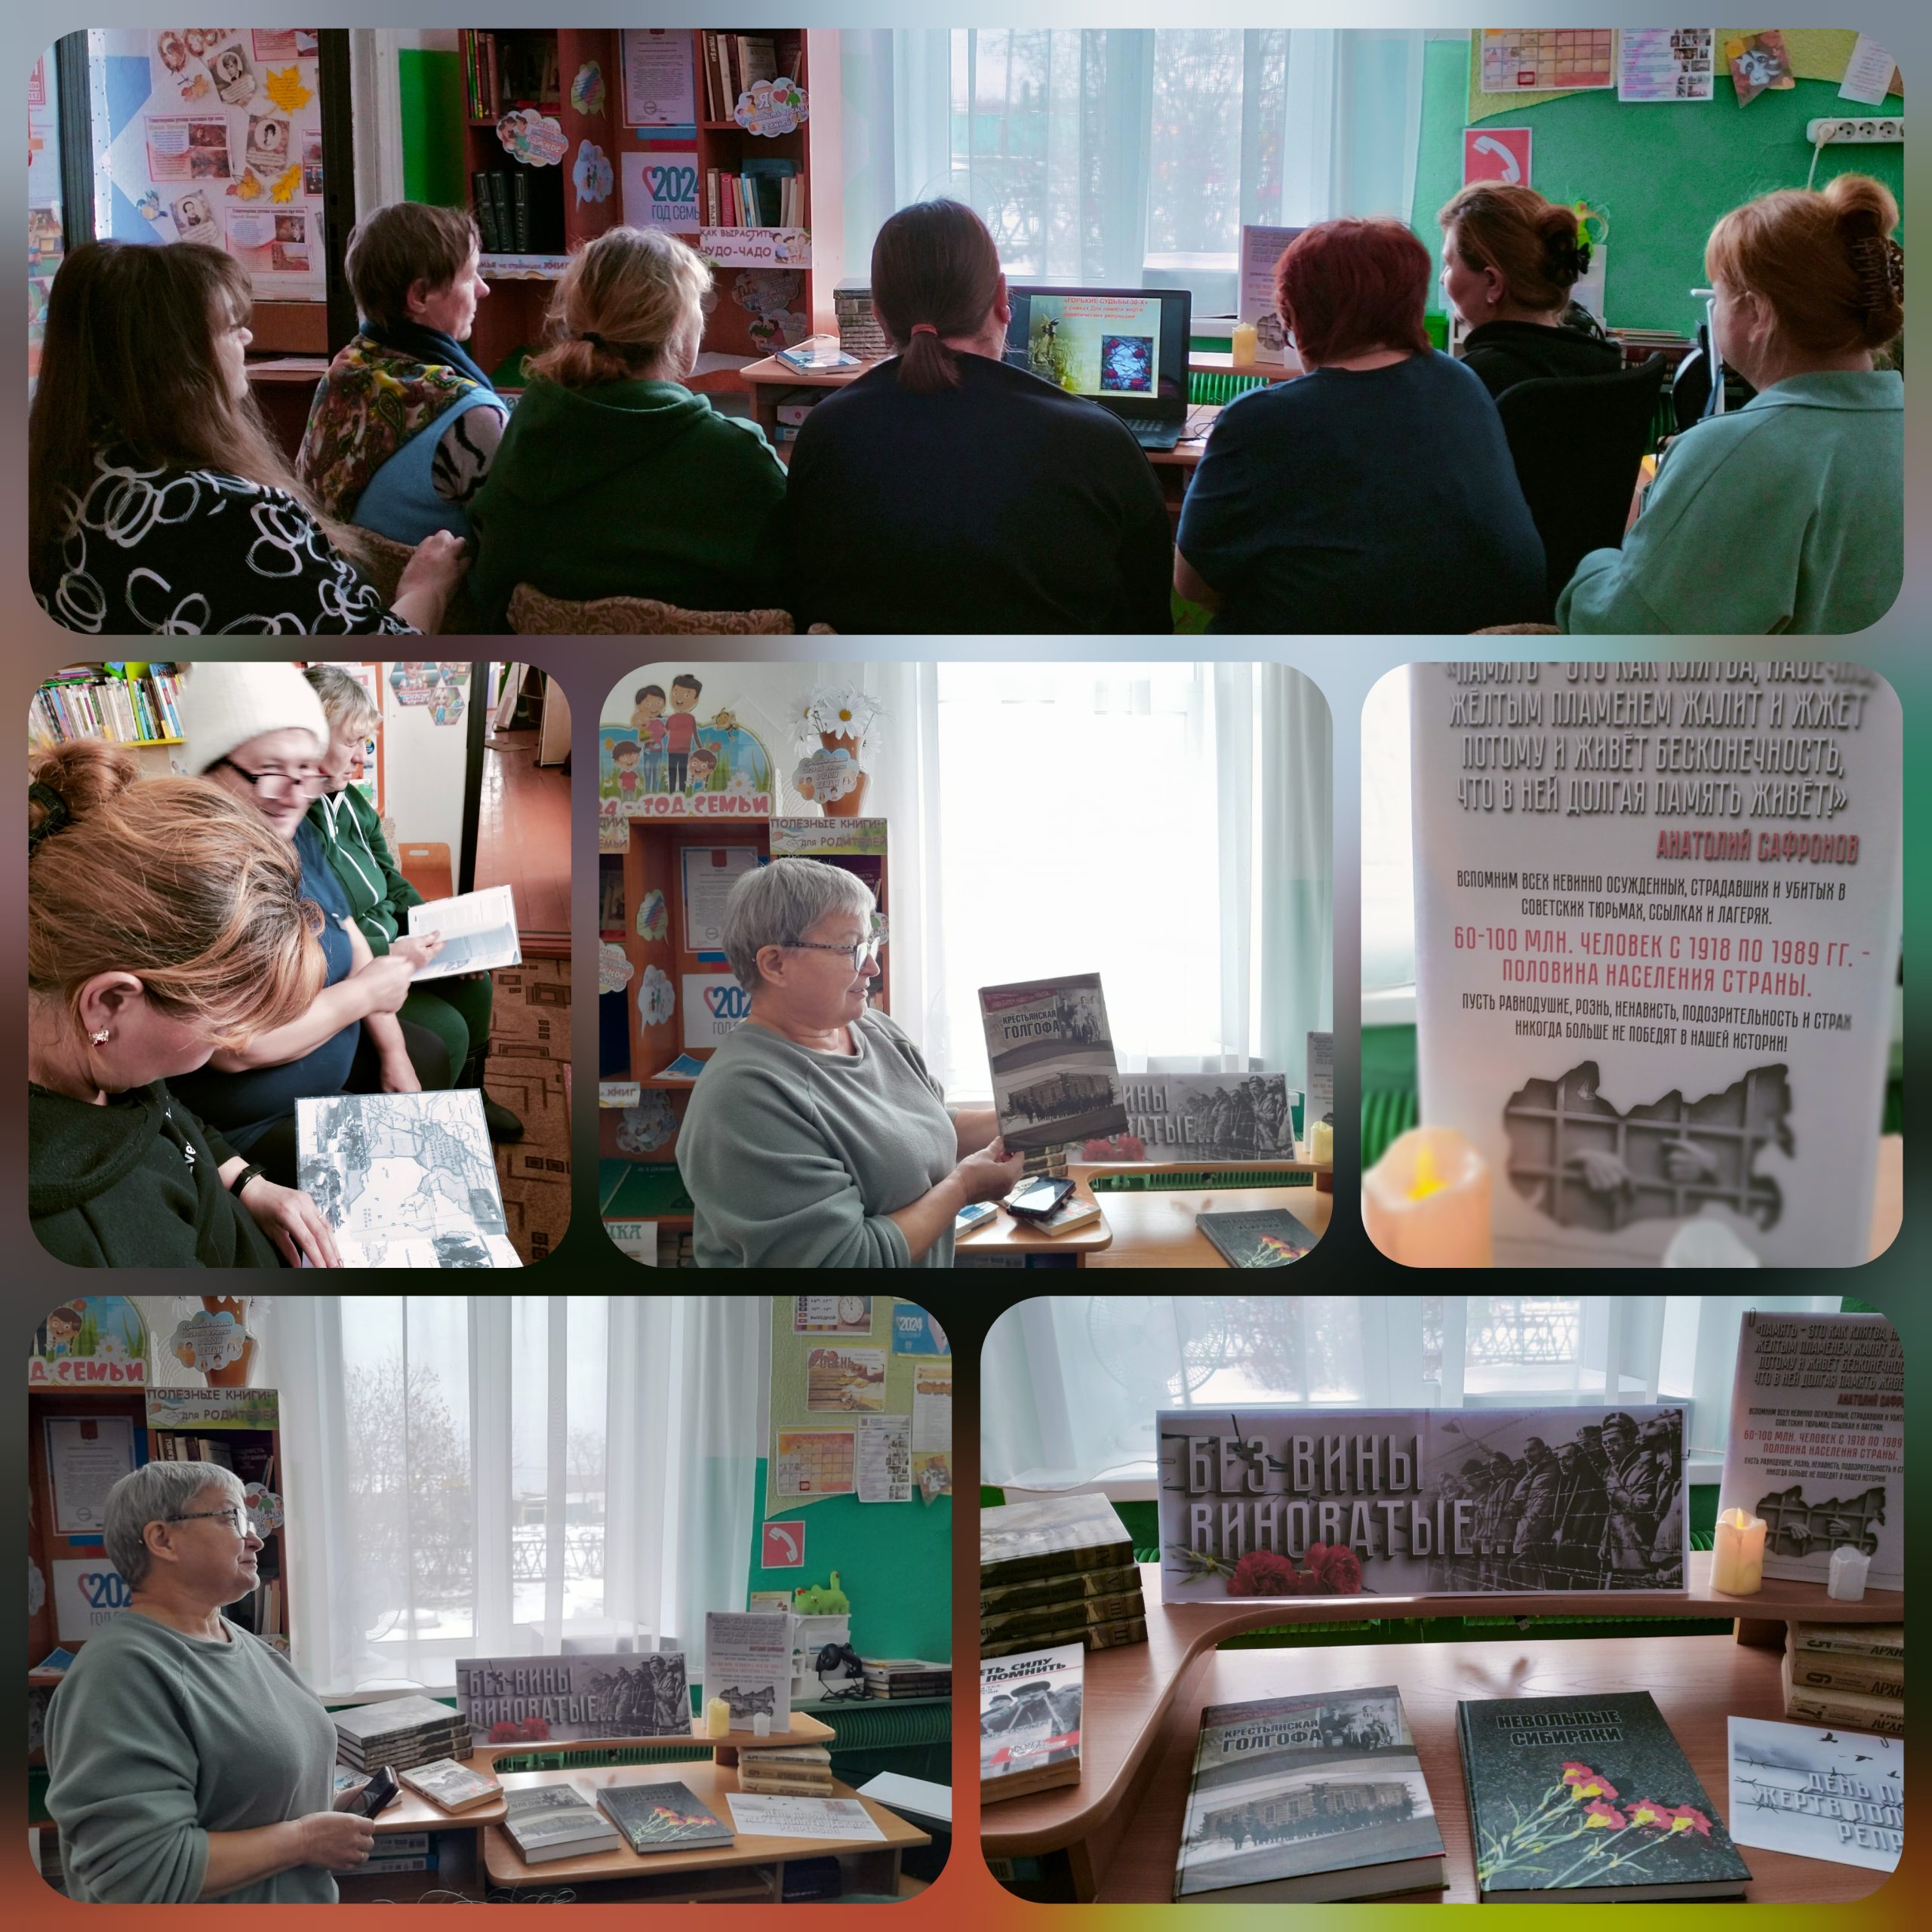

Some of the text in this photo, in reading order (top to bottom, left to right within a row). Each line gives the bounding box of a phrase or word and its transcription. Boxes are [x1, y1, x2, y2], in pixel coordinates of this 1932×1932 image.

[758, 91, 771, 109] Я
[652, 205, 670, 222] ГОД
[700, 229, 773, 239] КАК ВЫРАСТИТЬ
[701, 246, 771, 258] ЧУДО-ЧАДО
[1450, 688, 1542, 727] ЖЁЛТЫМ
[1551, 689, 1672, 728] ПЛАМЕНЕМ
[1681, 690, 1763, 728] ЖАЛИТ
[1769, 691, 1785, 728] И
[1463, 731, 1844, 778] ПОТОМУ И ЖИВЁТ БЕСКОНЕЧНОСТЬ,
[643, 796, 769, 814] ГОД СЕМЬИ
[1457, 773, 1847, 818] ЧТО В НЕЙ ДОЛГАЯ ПАМЯТЬ ЖИВЁТ!»
[771, 818, 875, 828] ПОЛЕЗНЫЕ КНИГИ
[801, 836, 887, 848] для РОДИТЕЛЕЙ
[1656, 829, 1860, 865] АНАТОЛИЙ САФРОНОВ
[1457, 870, 1846, 900] ВСПОМНИМ ВСЕХ НЕВИННО ОСУЖДЕННЫХ, СТРАДАВШИХ И УБИТЫХ В
[1521, 898, 1773, 924] СОВЕТСКИХ ТЮРЬМАХ, ССЫЛКАХ И ЛАГЕРЯХ.
[1454, 926, 1854, 968] 60-100 МЛН. ЧЕЛОВЕК С 1918 ПО 1989 ГГ.
[1503, 959, 1811, 998] ПОЛОВИНА НАСЕЛЕНИЯ СТРАНЫ.
[1002, 1010, 1057, 1024] КРЕСТЬЯНСКАЯ
[1463, 993, 1495, 1011] ПУСТЬ
[1499, 995, 1572, 1016] РАВНОДУШИЕ,
[1576, 998, 1612, 1018] РОЗНЬ,
[1615, 1001, 1679, 1022] НЕНАВИСТЬ,
[1682, 1004, 1798, 1028] ПОДОЗРИТЕЛЬНОСТЬ
[1803, 1012, 1810, 1029] И
[1004, 1020, 1060, 1039] ГОЛГОФА
[1515, 1020, 1788, 1053] НИКОГДА БОЛЬШЕ НЕ ПОБЕДЯТ В НАШЕЙ ИСТОРИИ!
[900, 1317, 922, 1331] 2024
[1756, 1323, 1887, 1342] «ПАМЯТЬ ЭТО КАК КЛЯТВА,
[1755, 1339, 1796, 1354] ЖЁЛТЫМ
[1800, 1341, 1850, 1355] ПЛАМЕНЕМ
[1854, 1343, 1887, 1357] ЖАЛИТ
[58, 1361, 143, 1381] СЕМЬИ
[1758, 1355, 1795, 1370] ПОТОМУ
[1798, 1357, 1807, 1371] И
[1807, 1356, 1840, 1371] ЖИВЁТ
[1755, 1371, 1875, 1390] ЧТО В НЕЙ ДОЛГАЯ ПАМЯТЬ
[146, 1389, 266, 1401] ПОЛЕЗНЫЕ КНИГИ
[181, 1410, 198, 1420] для
[1744, 1430, 1903, 1448] 60-100 МЛН. ЧЕЛОВЕК С 1918 ПО 1989
[1763, 1443, 1898, 1460] ПОЛОВИНА НАСЕЛЕНИЯ СТРАНЫ.
[1186, 1434, 1425, 1495] БЕЗ ВИНЫ
[1188, 1500, 1521, 1558] ВИНОВАТЫЕ...
[1807, 1639, 1832, 1649] 5
[986, 1663, 1066, 1682] ПОМНИТЬ
[1011, 1657, 1053, 1670] СИЛУ
[469, 1666, 574, 1697] БЕЗ ВИНЫ
[1497, 1709, 1622, 1729] НЕВОЛЬНЫЕ
[1224, 1720, 1318, 1739] КРЕСТЬЯНСКАЯ
[1510, 1726, 1622, 1747] СИБИРЯКИ
[1223, 1729, 1322, 1752] ГОЛГОФА
[1808, 1774, 1870, 1799] ДЕНЬ
[1756, 1786, 1843, 1817] ЖЕРТВ
